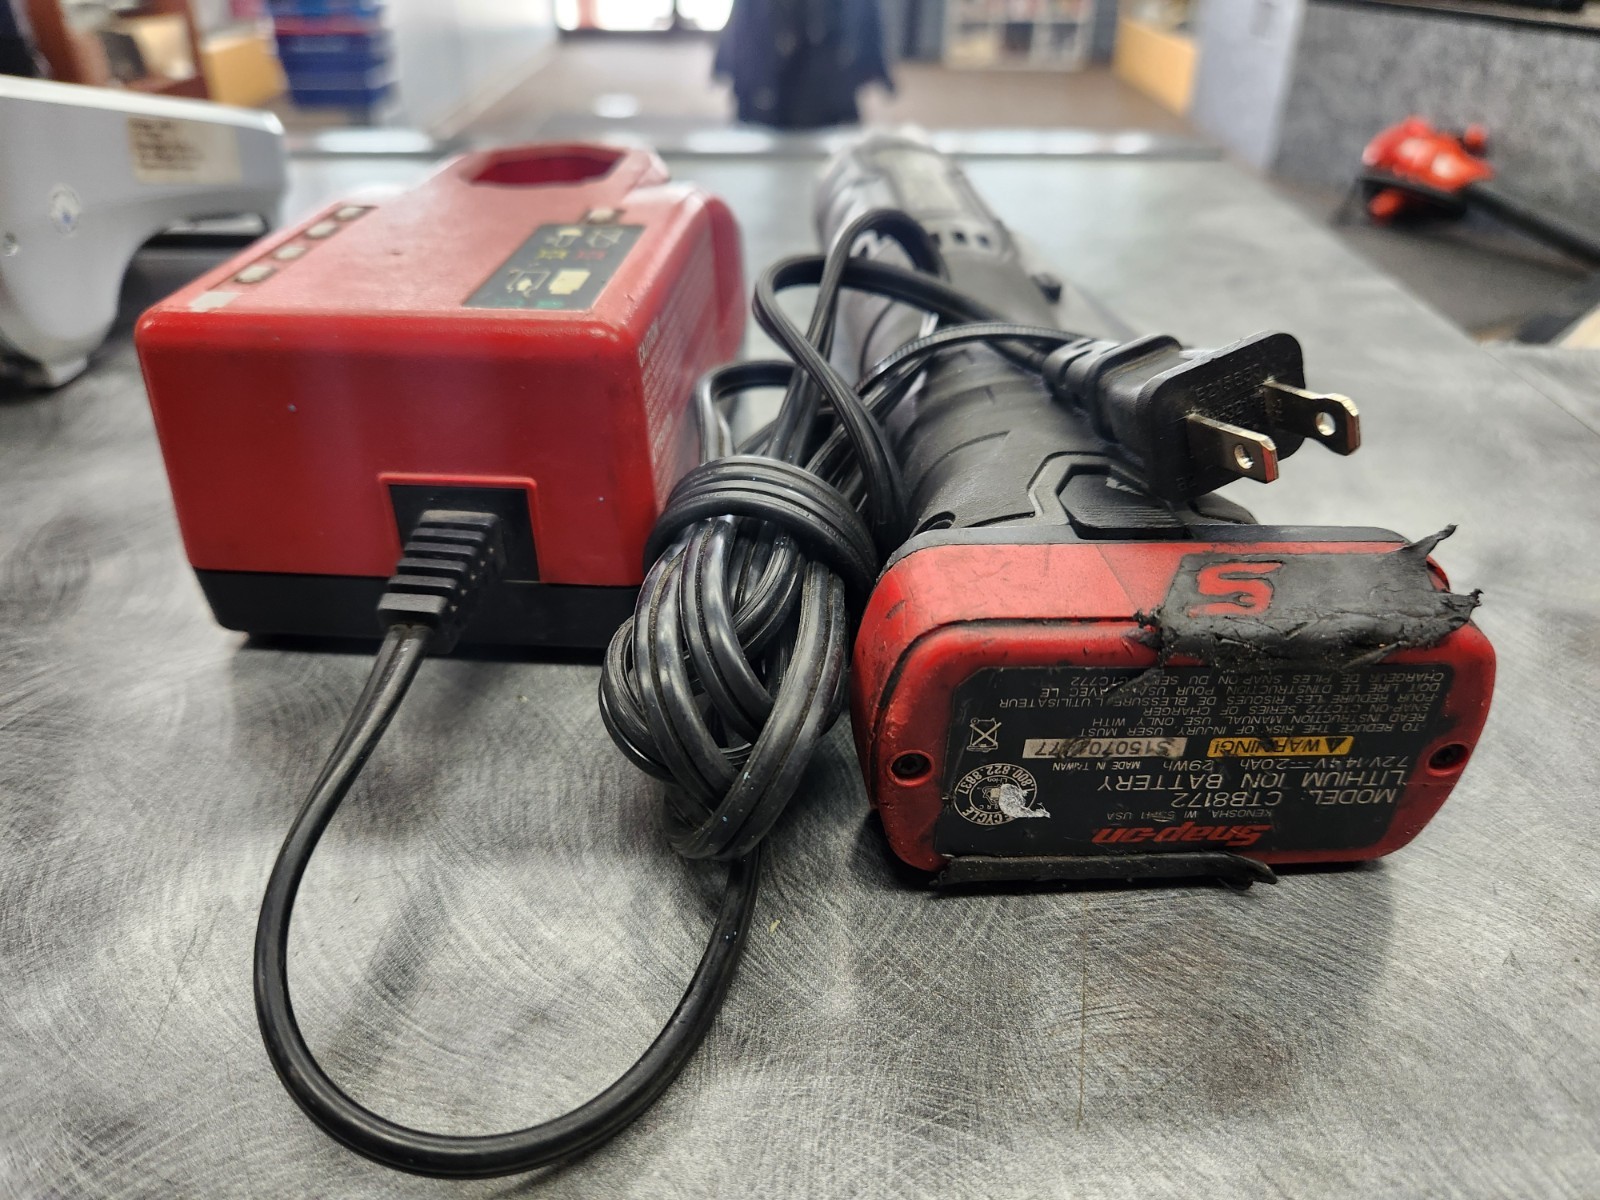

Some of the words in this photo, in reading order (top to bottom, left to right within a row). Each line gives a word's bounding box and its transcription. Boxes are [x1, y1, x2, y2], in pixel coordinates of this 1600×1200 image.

[1187, 561, 1284, 618] S
[1189, 675, 1209, 685] DU
[1292, 674, 1332, 684] PILES
[1340, 673, 1360, 683] DE
[1369, 672, 1444, 682] CHARGEUR
[1176, 686, 1215, 695] POUR
[1340, 684, 1360, 693] LE
[1368, 683, 1399, 693] LIRE
[1409, 682, 1440, 692] DOIT
[1040, 688, 1059, 698] LE
[1331, 693, 1388, 703] REDUIRE
[1197, 696, 1217, 706] DE
[1227, 695, 1285, 705] RISQUES
[1295, 695, 1322, 704] LES
[1143, 706, 1210, 716] CHARGER
[1220, 706, 1238, 715] OF
[1249, 705, 1297, 715] SERIES
[1305, 704, 1360, 713] CTC772
[1369, 703, 1431, 712] SNAP-ON
[1092, 717, 1126, 727] WITH
[1137, 717, 1174, 726] ONLY
[1184, 716, 1211, 725] USE
[1291, 714, 1381, 724] INSTRUCTION
[1389, 713, 1427, 722] READ
[1079, 728, 1117, 737] MUST
[1127, 727, 1163, 736] USER
[1235, 725, 1254, 734] OF
[1265, 725, 1294, 734] RISK
[1303, 724, 1328, 733] THE
[1339, 723, 1394, 733] REDUCE
[1034, 740, 1172, 757] S1507077
[1052, 762, 1089, 771] TAIWAN
[1096, 762, 1106, 770] IN
[1112, 760, 1141, 770] MADE
[1163, 759, 1212, 771] 29Wh
[958, 765, 1035, 794] 1.800.822.8837
[1097, 774, 1223, 791] BATTERY
[1241, 773, 1285, 788] ION
[1302, 770, 1405, 788] LITHIUM
[1171, 790, 1282, 808] CTB8172
[1106, 812, 1132, 820] USA
[1141, 811, 1175, 820] 541
[1092, 821, 1272, 847] Snap-on
